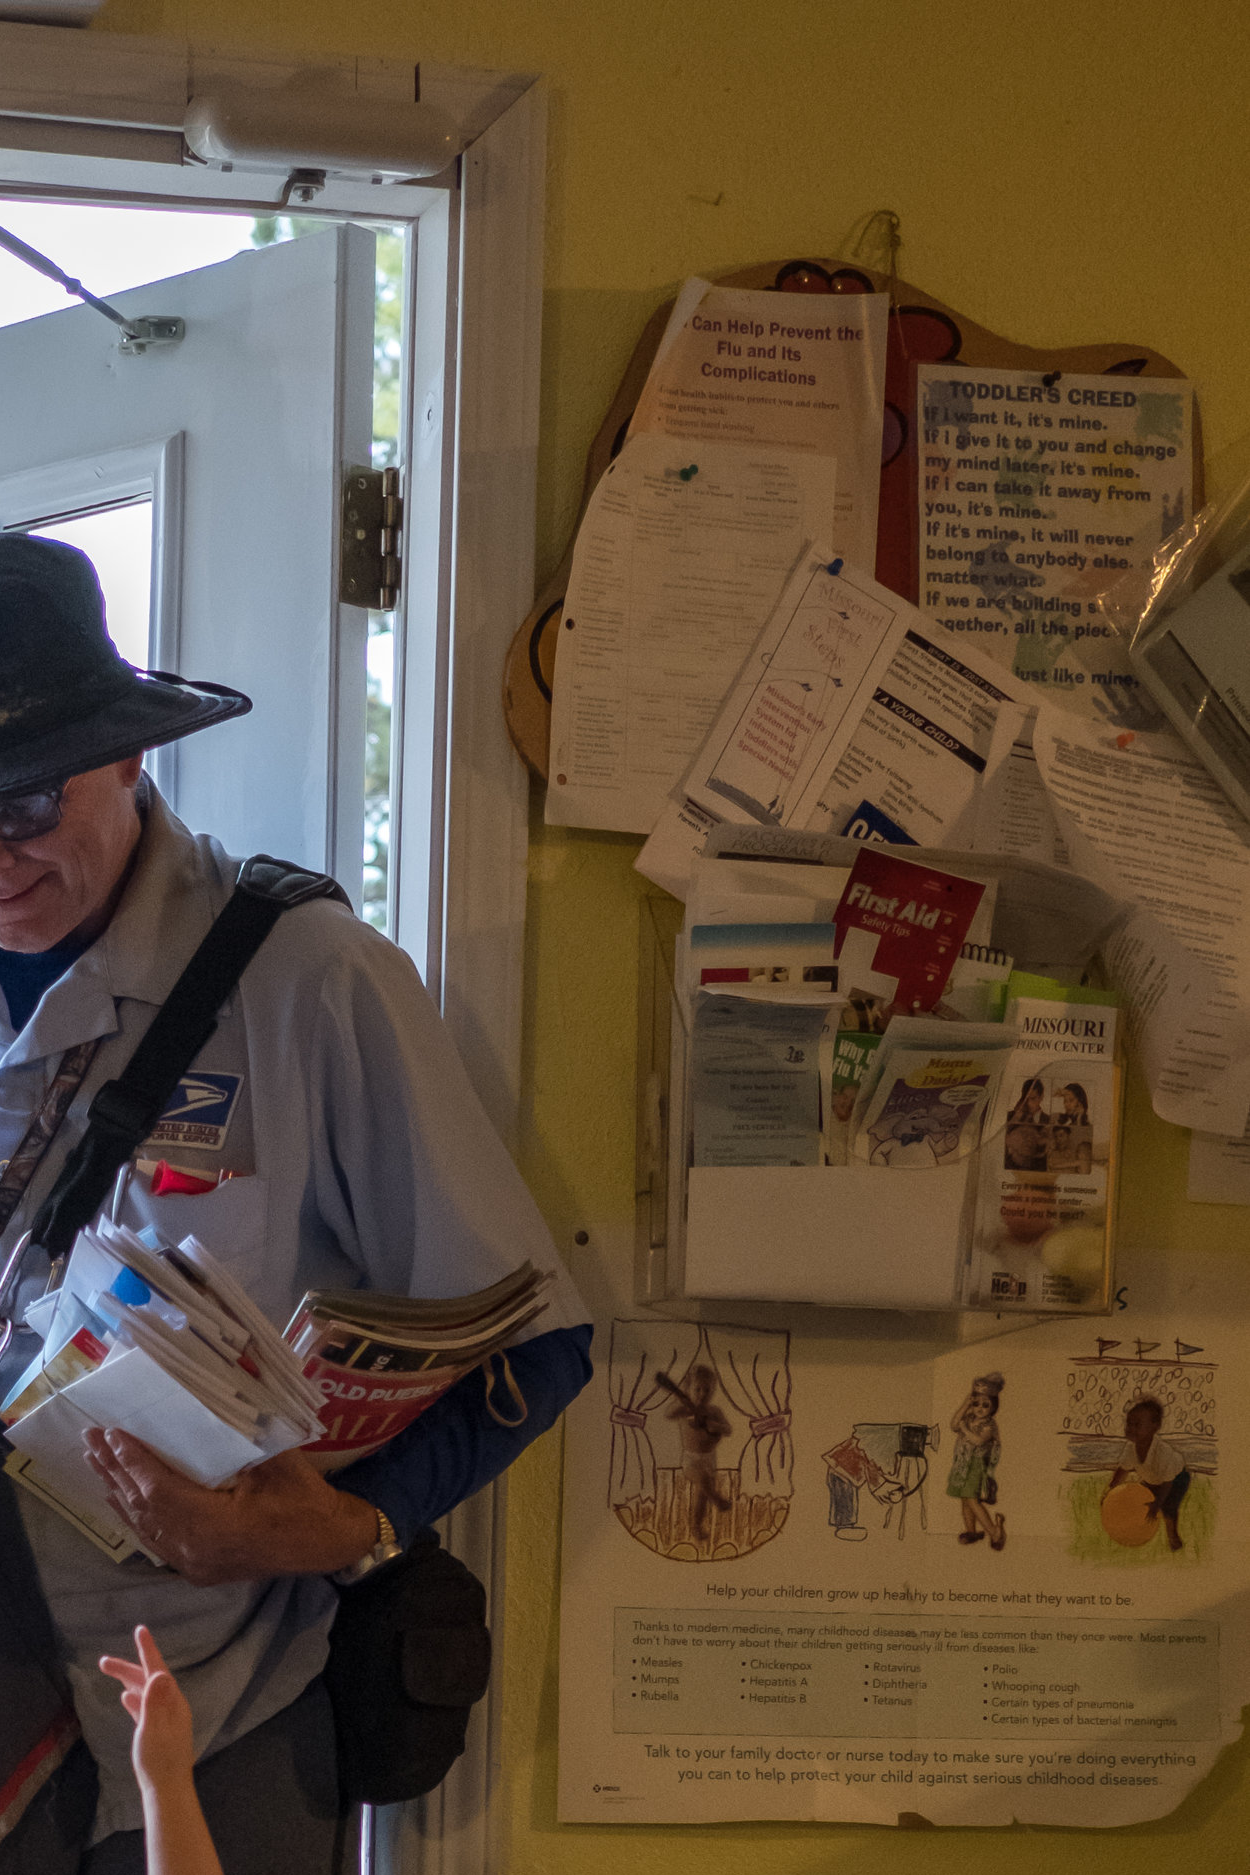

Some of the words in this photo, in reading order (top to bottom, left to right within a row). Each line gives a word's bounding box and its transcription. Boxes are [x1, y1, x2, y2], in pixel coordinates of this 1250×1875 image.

[692, 315, 722, 332] Can
[727, 319, 765, 338] Help
[769, 322, 831, 340] Prevent
[837, 325, 864, 341] the
[717, 341, 742, 357] Flu
[747, 344, 777, 359] and
[782, 346, 802, 362] Its
[701, 362, 817, 386] Complications
[950, 381, 1061, 404] TODDLER'S
[1068, 388, 1137, 408] CREED
[924, 406, 939, 422] If
[955, 409, 999, 425] want
[1004, 411, 1022, 428] it,
[1027, 412, 1053, 428] it's
[1059, 416, 1108, 431] mine.
[925, 429, 939, 444] If
[956, 434, 991, 450] give
[996, 434, 1010, 448] it
[1015, 436, 1032, 450] to
[1038, 438, 1069, 453] you
[1074, 440, 1108, 454] and
[1113, 443, 1177, 460] change
[925, 455, 950, 472] my
[957, 456, 1000, 472] mind
[1006, 459, 1055, 476] later,
[1061, 460, 1085, 476] it's
[1092, 463, 1141, 479] mine.
[925, 477, 939, 491] If
[956, 480, 988, 493] can
[994, 480, 1034, 496] take
[1040, 482, 1052, 497] it
[1057, 486, 1102, 503] away
[1108, 486, 1150, 501] from
[925, 502, 962, 517] you,
[968, 500, 993, 516] it's
[999, 506, 1048, 520] mine.
[926, 521, 939, 536] If
[945, 522, 971, 538] it's
[977, 526, 1025, 542] mine,
[1032, 528, 1044, 542] it
[1051, 529, 1079, 543] will
[1085, 534, 1134, 547] never
[927, 545, 985, 566] belong
[991, 549, 1009, 564] to
[1015, 552, 1087, 571] anybody
[1093, 555, 1133, 569] else.
[927, 570, 989, 585] matter
[993, 573, 1042, 588] what.
[927, 591, 940, 606] If
[945, 594, 970, 608] we
[976, 595, 1006, 609] are
[1012, 596, 1081, 617] building
[1014, 620, 1036, 634] all
[1041, 620, 1068, 637] the
[1015, 666, 1048, 682] just
[1053, 668, 1085, 683] like
[1091, 670, 1140, 687] mine,
[890, 702, 926, 729] YOUNG
[924, 725, 960, 751] CHILD?
[846, 882, 900, 918] First
[899, 900, 941, 930] Aid
[861, 914, 890, 932] Safety
[892, 923, 910, 937] Tips
[1023, 1016, 1104, 1038] MISSOURI
[1016, 1039, 1053, 1051] POISON
[1054, 1041, 1104, 1054] CENTER
[317, 1379, 366, 1401] OLD
[706, 1583, 737, 1599] Help
[740, 1585, 768, 1601] your
[774, 1585, 823, 1599] children
[827, 1589, 859, 1603] grow
[862, 1591, 879, 1603] up
[932, 1590, 945, 1603] to
[948, 1590, 998, 1604] become
[1002, 1592, 1032, 1604] what
[1036, 1592, 1062, 1607] they
[1066, 1593, 1095, 1605] want
[1100, 1594, 1112, 1605] to
[1116, 1594, 1134, 1606] be.
[641, 1657, 683, 1668] Measles
[750, 1659, 812, 1671] Chickenpox
[873, 1663, 921, 1673] Rotavirus
[872, 1679, 927, 1689] Diphtheria
[645, 1745, 670, 1758] Talk
[676, 1747, 690, 1759] to
[695, 1749, 726, 1762] your
[730, 1746, 771, 1763] family
[775, 1747, 822, 1761] doctor
[826, 1751, 842, 1761] or
[846, 1752, 884, 1762] nurse
[889, 1750, 928, 1766] today
[933, 1752, 948, 1764] to
[952, 1752, 990, 1764] make
[995, 1753, 1024, 1764] sure
[1028, 1752, 1072, 1767] you're
[1076, 1753, 1117, 1768] doing
[1120, 1753, 1196, 1768] everything
[678, 1769, 703, 1783] you
[708, 1770, 731, 1781] can
[736, 1769, 751, 1781] to
[755, 1768, 786, 1784] help
[791, 1770, 840, 1784] protect
[845, 1772, 875, 1785] your
[880, 1769, 913, 1783] child
[918, 1772, 968, 1787] against
[973, 1772, 1022, 1785] serious
[1026, 1772, 1095, 1787] childhood
[1100, 1773, 1162, 1787] diseases.
